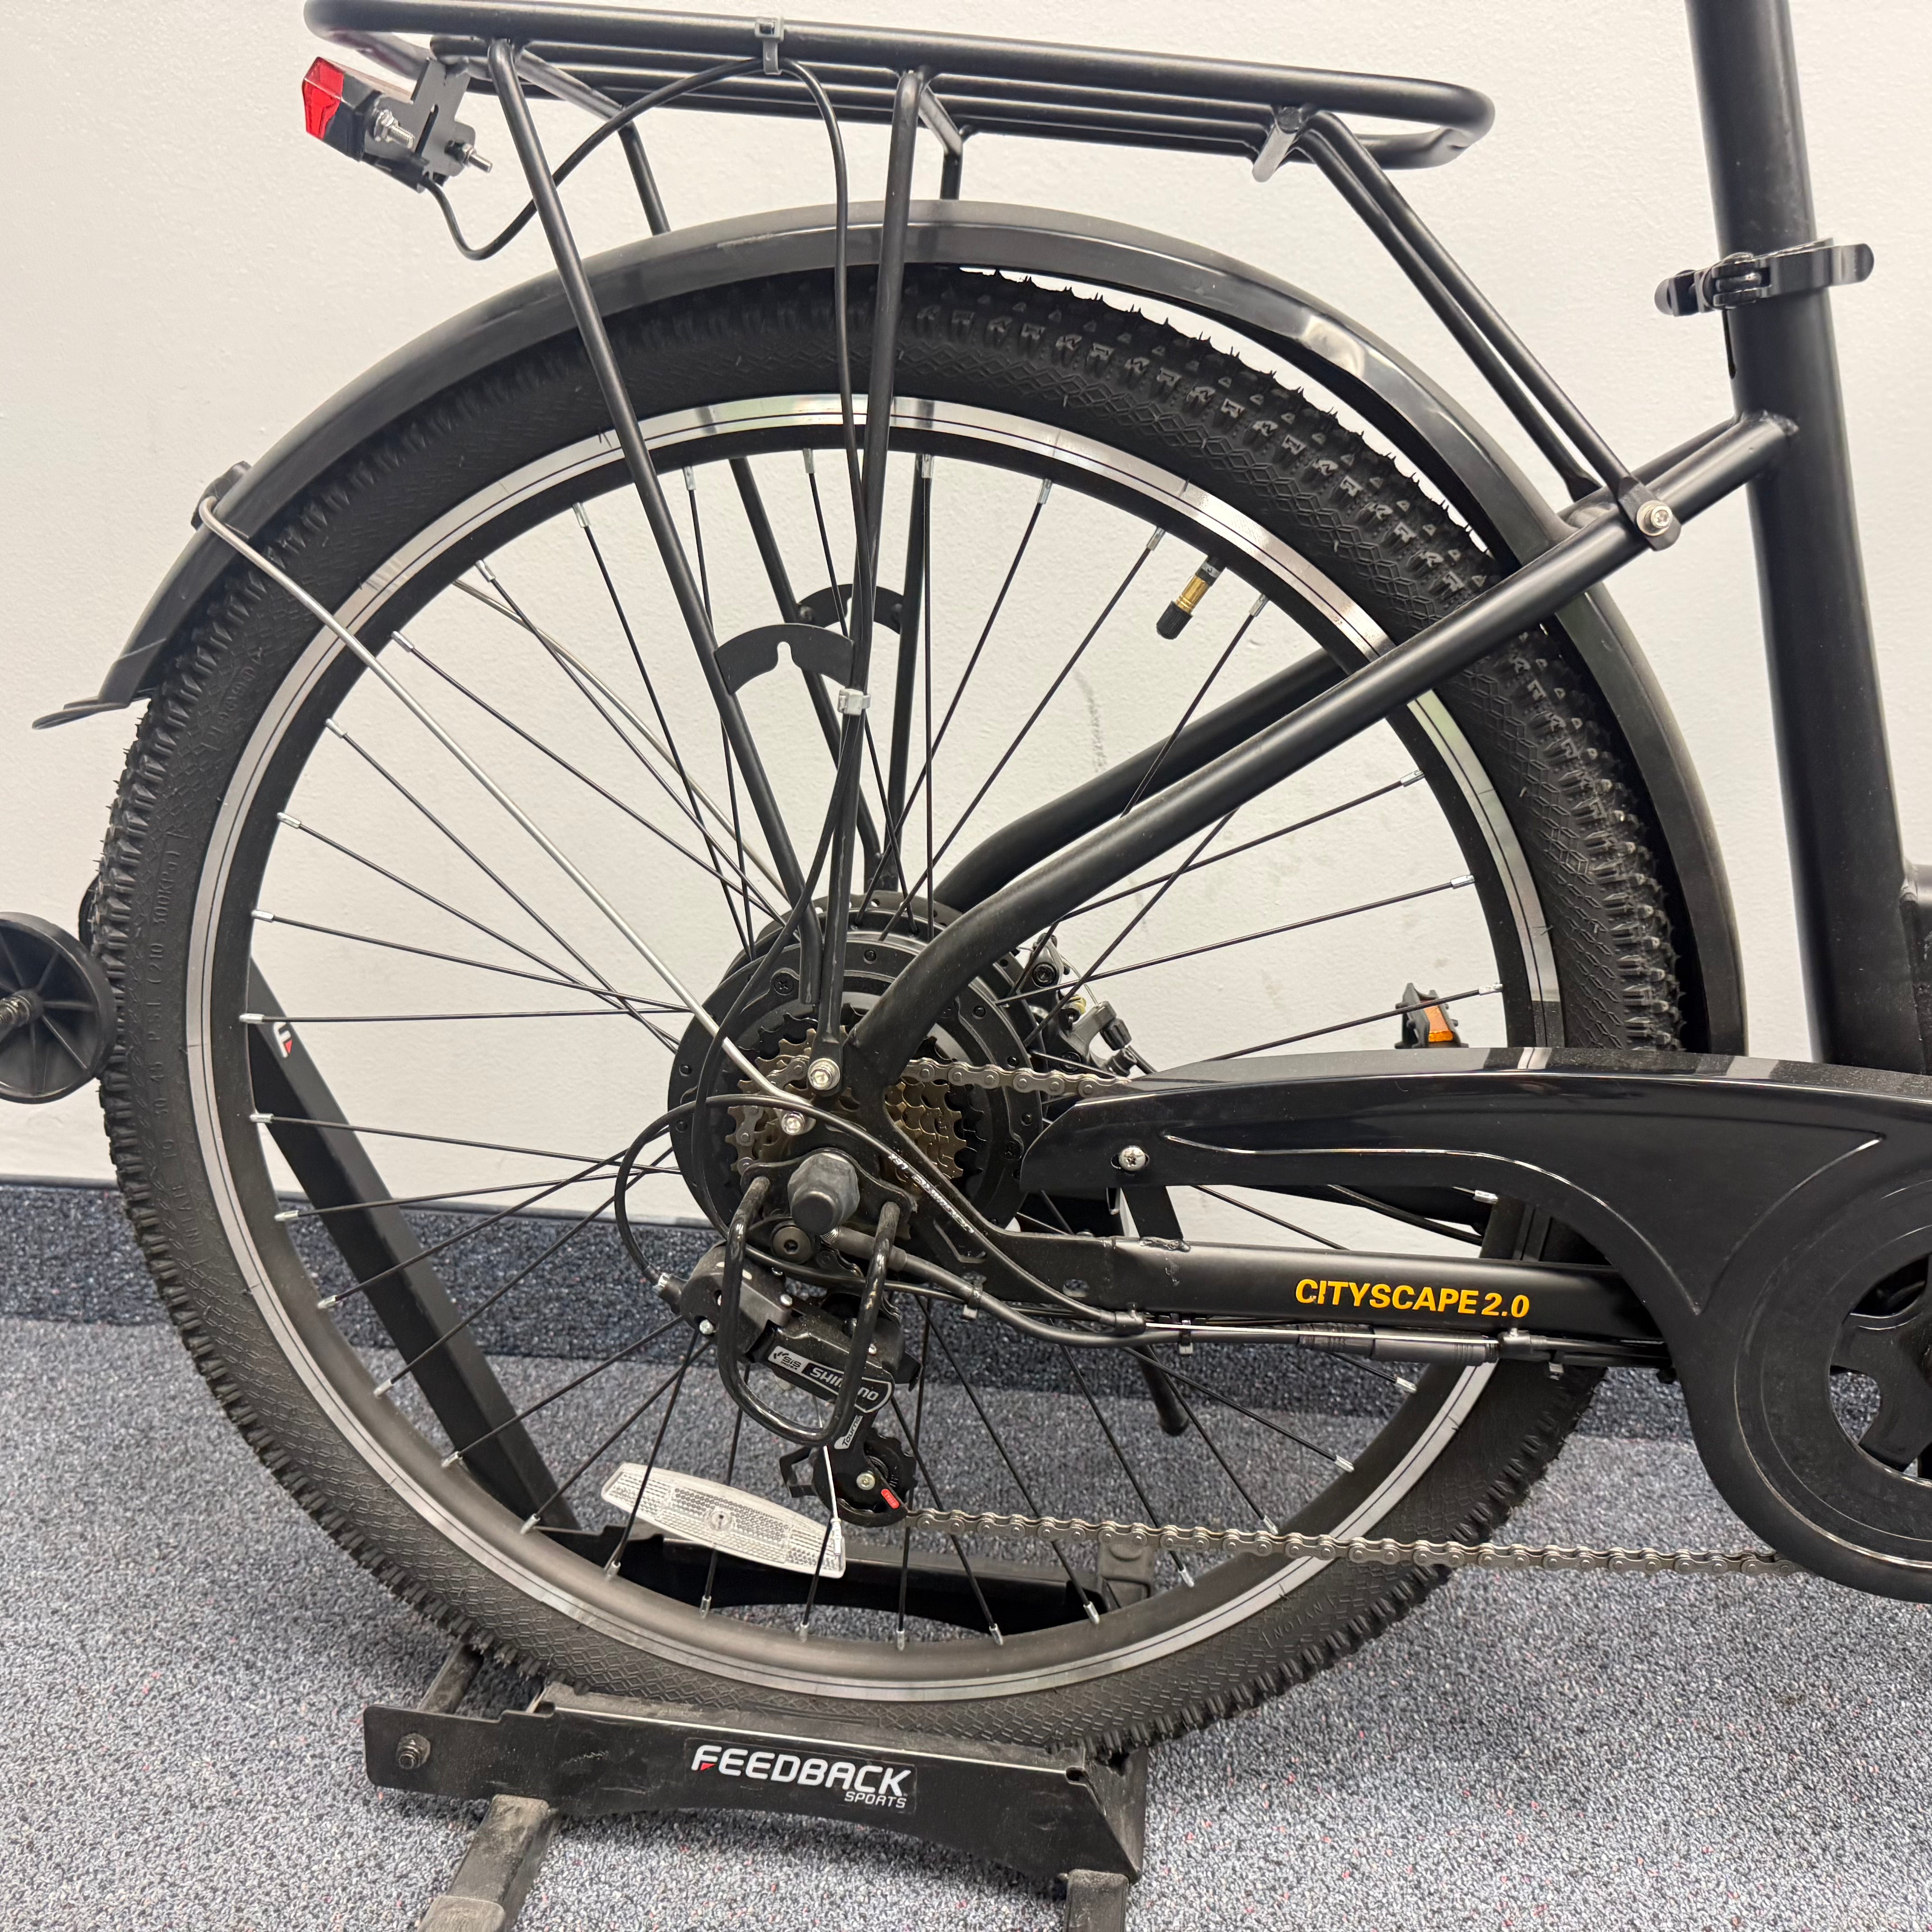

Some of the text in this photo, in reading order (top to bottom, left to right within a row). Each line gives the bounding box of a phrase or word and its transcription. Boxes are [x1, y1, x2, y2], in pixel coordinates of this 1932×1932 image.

[1295, 1279, 1530, 1318] CITYSCAPE 2.0
[691, 1744, 911, 1797] FEEDBACK
[844, 1791, 907, 1808] SPORTS
